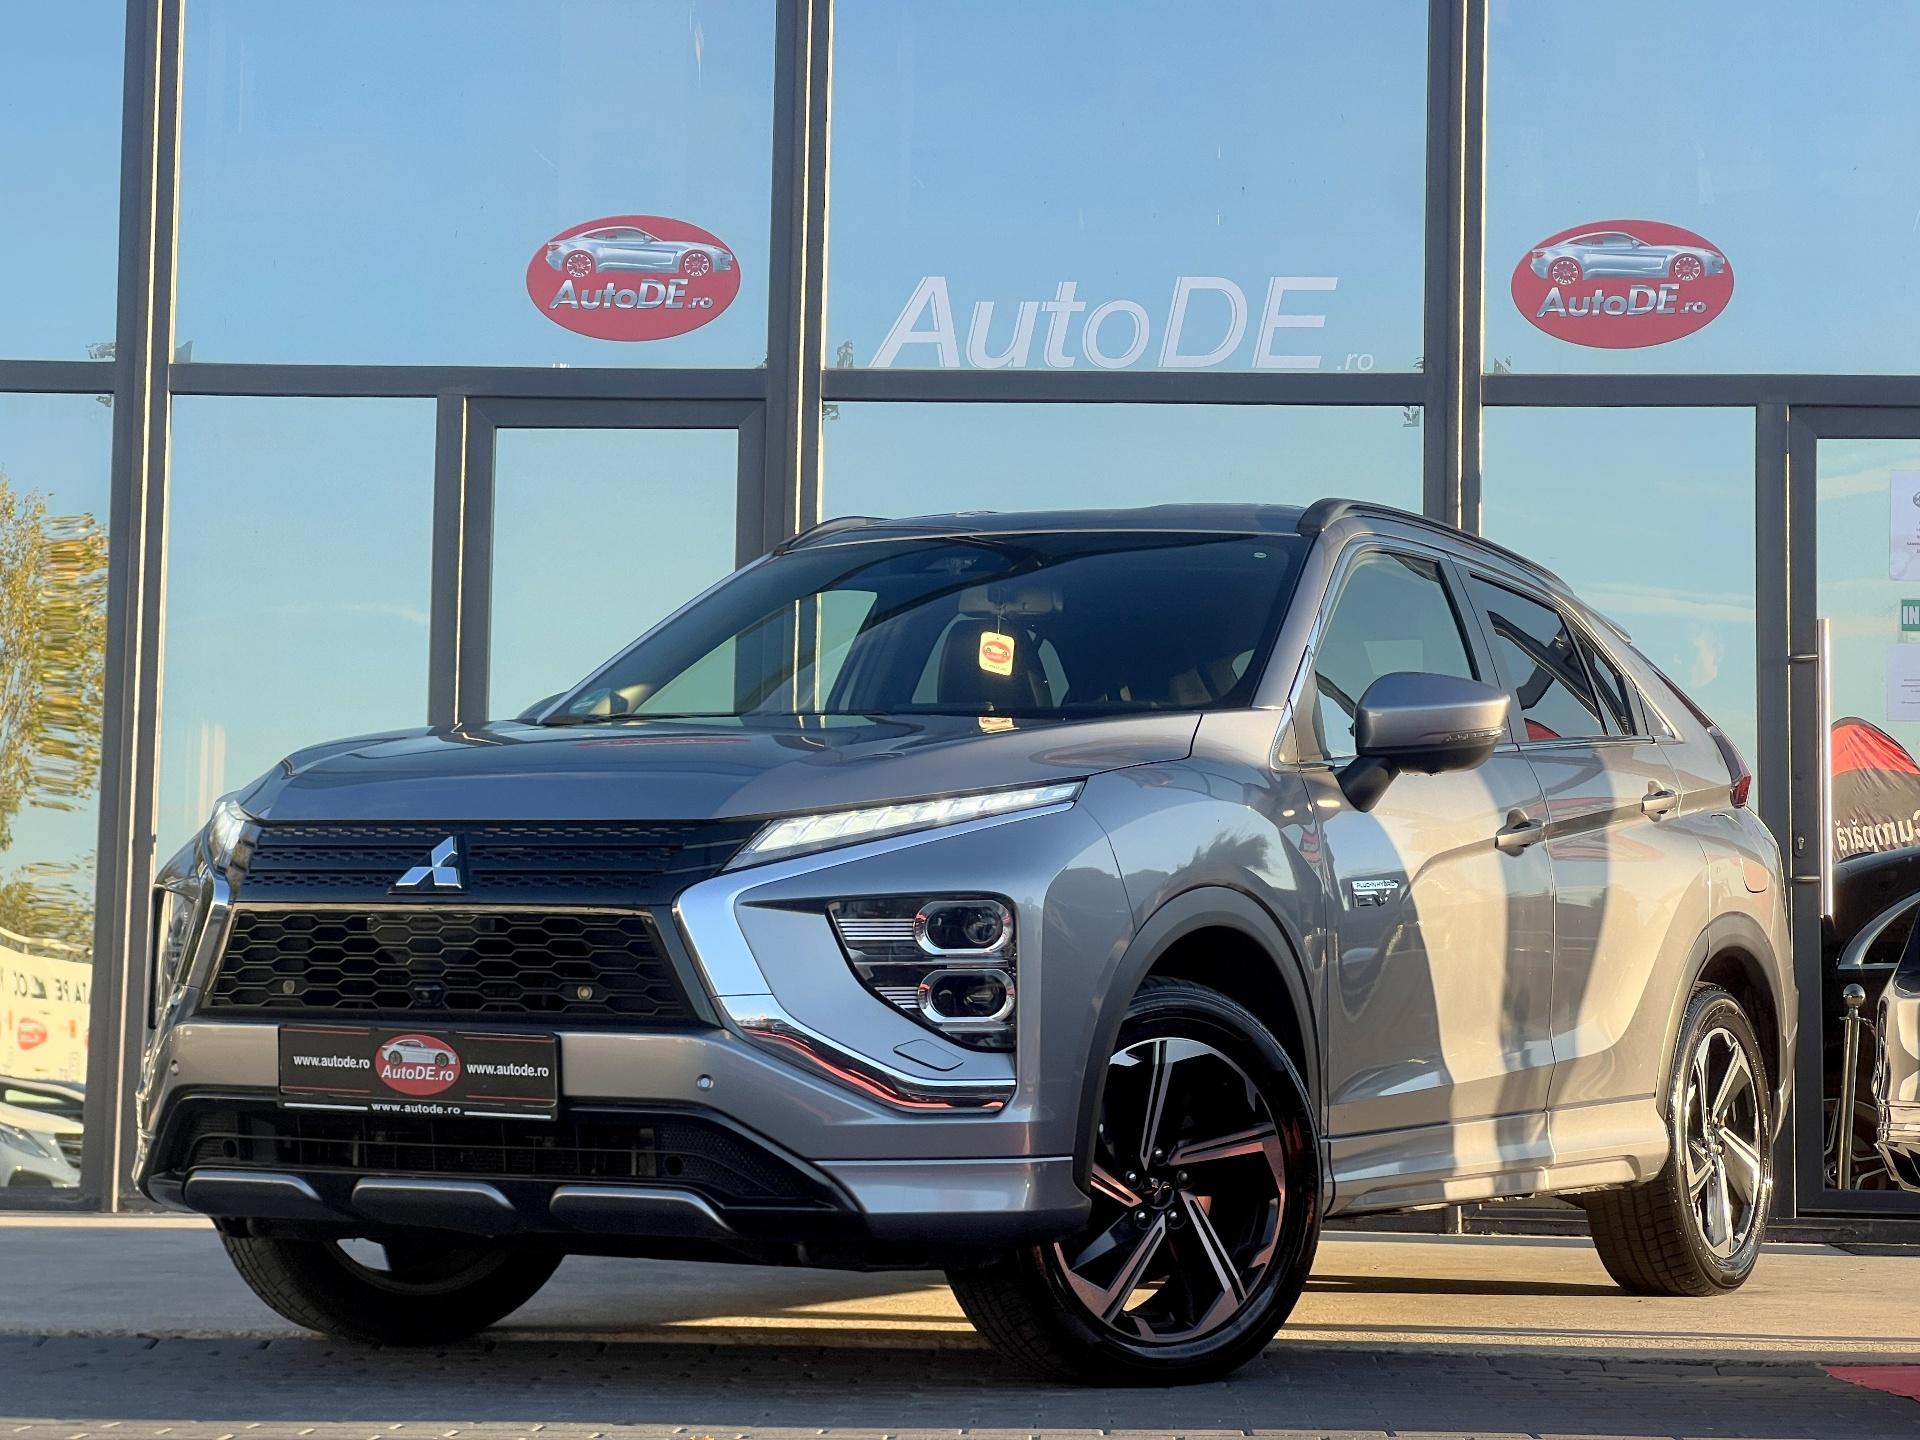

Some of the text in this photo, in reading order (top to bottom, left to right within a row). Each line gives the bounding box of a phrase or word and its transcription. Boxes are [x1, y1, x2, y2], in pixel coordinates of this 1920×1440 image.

[549, 278, 714, 310] AutoDE.ro
[1536, 283, 1708, 319] AutoDE.ro
[293, 1055, 370, 1069] www.autode.ro
[381, 1064, 455, 1082] AutoDE.ro
[466, 1063, 549, 1078] www.autode.ro
[371, 1102, 461, 1115] www.autode.ro
